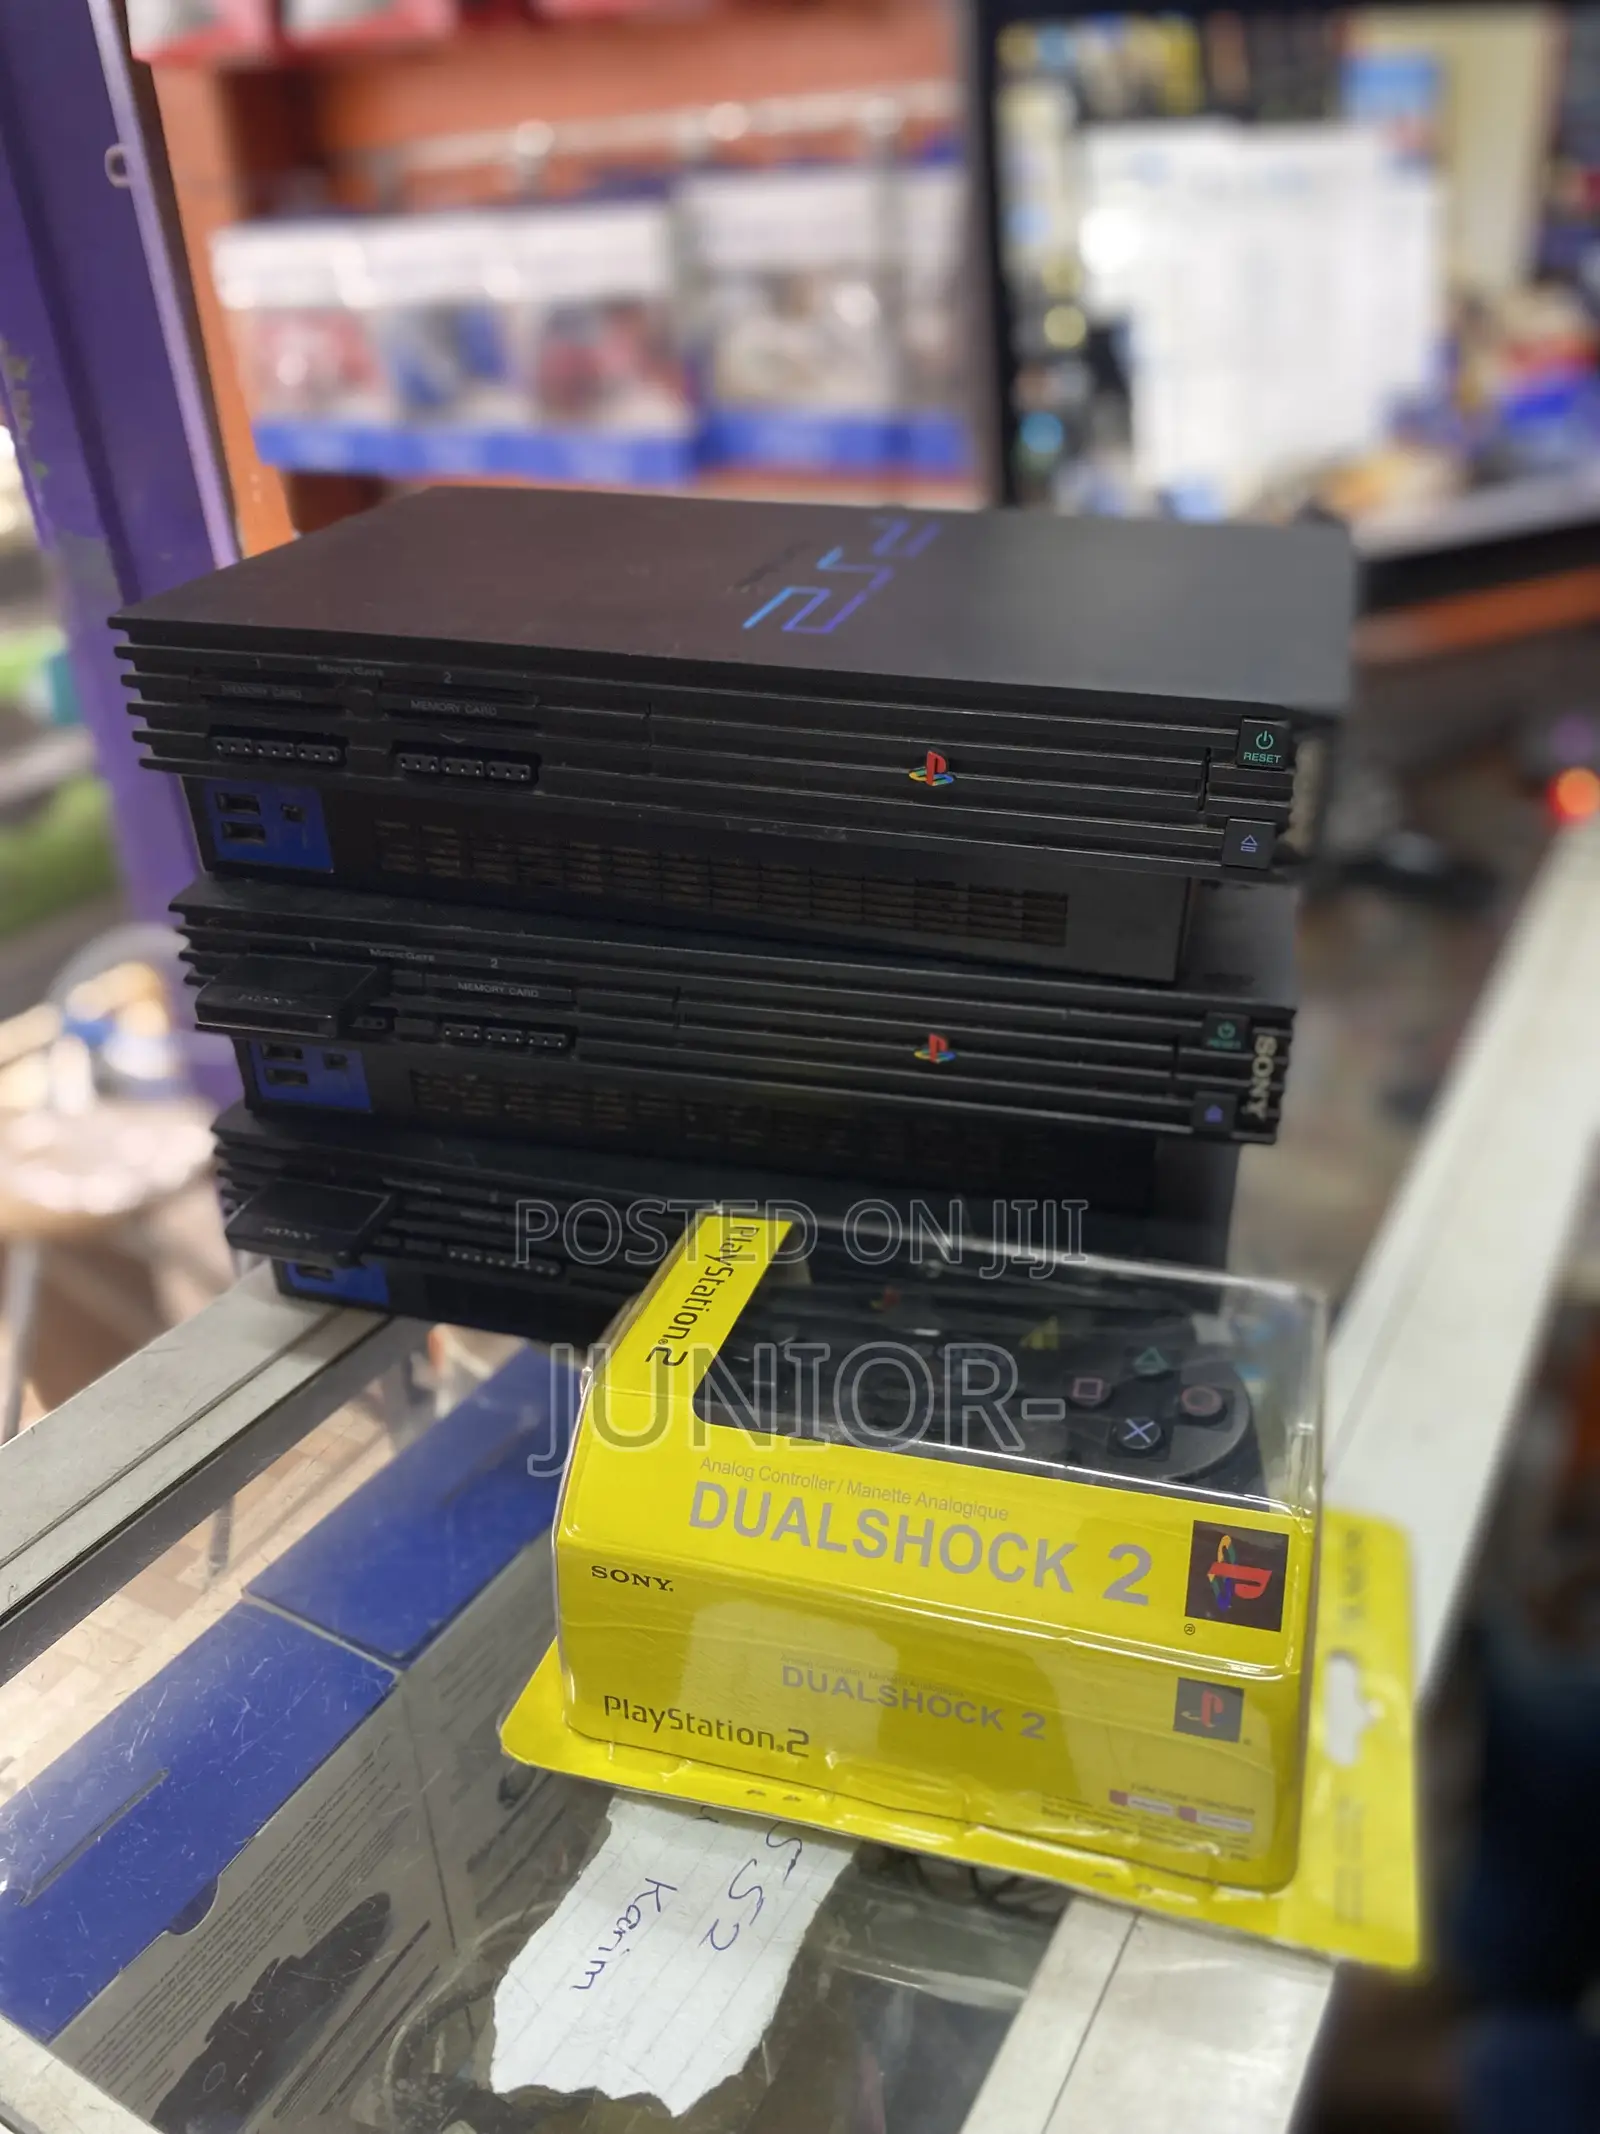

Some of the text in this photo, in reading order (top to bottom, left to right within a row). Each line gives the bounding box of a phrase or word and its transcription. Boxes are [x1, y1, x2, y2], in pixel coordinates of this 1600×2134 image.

[442, 671, 453, 684] 2
[410, 699, 460, 713] MEMORY
[1243, 751, 1282, 764] RESET
[490, 957, 499, 969] 2
[457, 981, 540, 998] MEMORY CARD
[1240, 1034, 1278, 1120] SONY
[700, 1456, 755, 1482] Analog
[758, 1465, 836, 1493] Controller
[846, 1479, 912, 1505] Manette
[915, 1490, 1010, 1522] Analogique
[688, 1480, 1154, 1606] DUALSHOCK 2
[781, 1664, 1005, 1732] DUALSHOCK
[1019, 1710, 1047, 1740] 2
[571, 1877, 678, 1990] Karim
